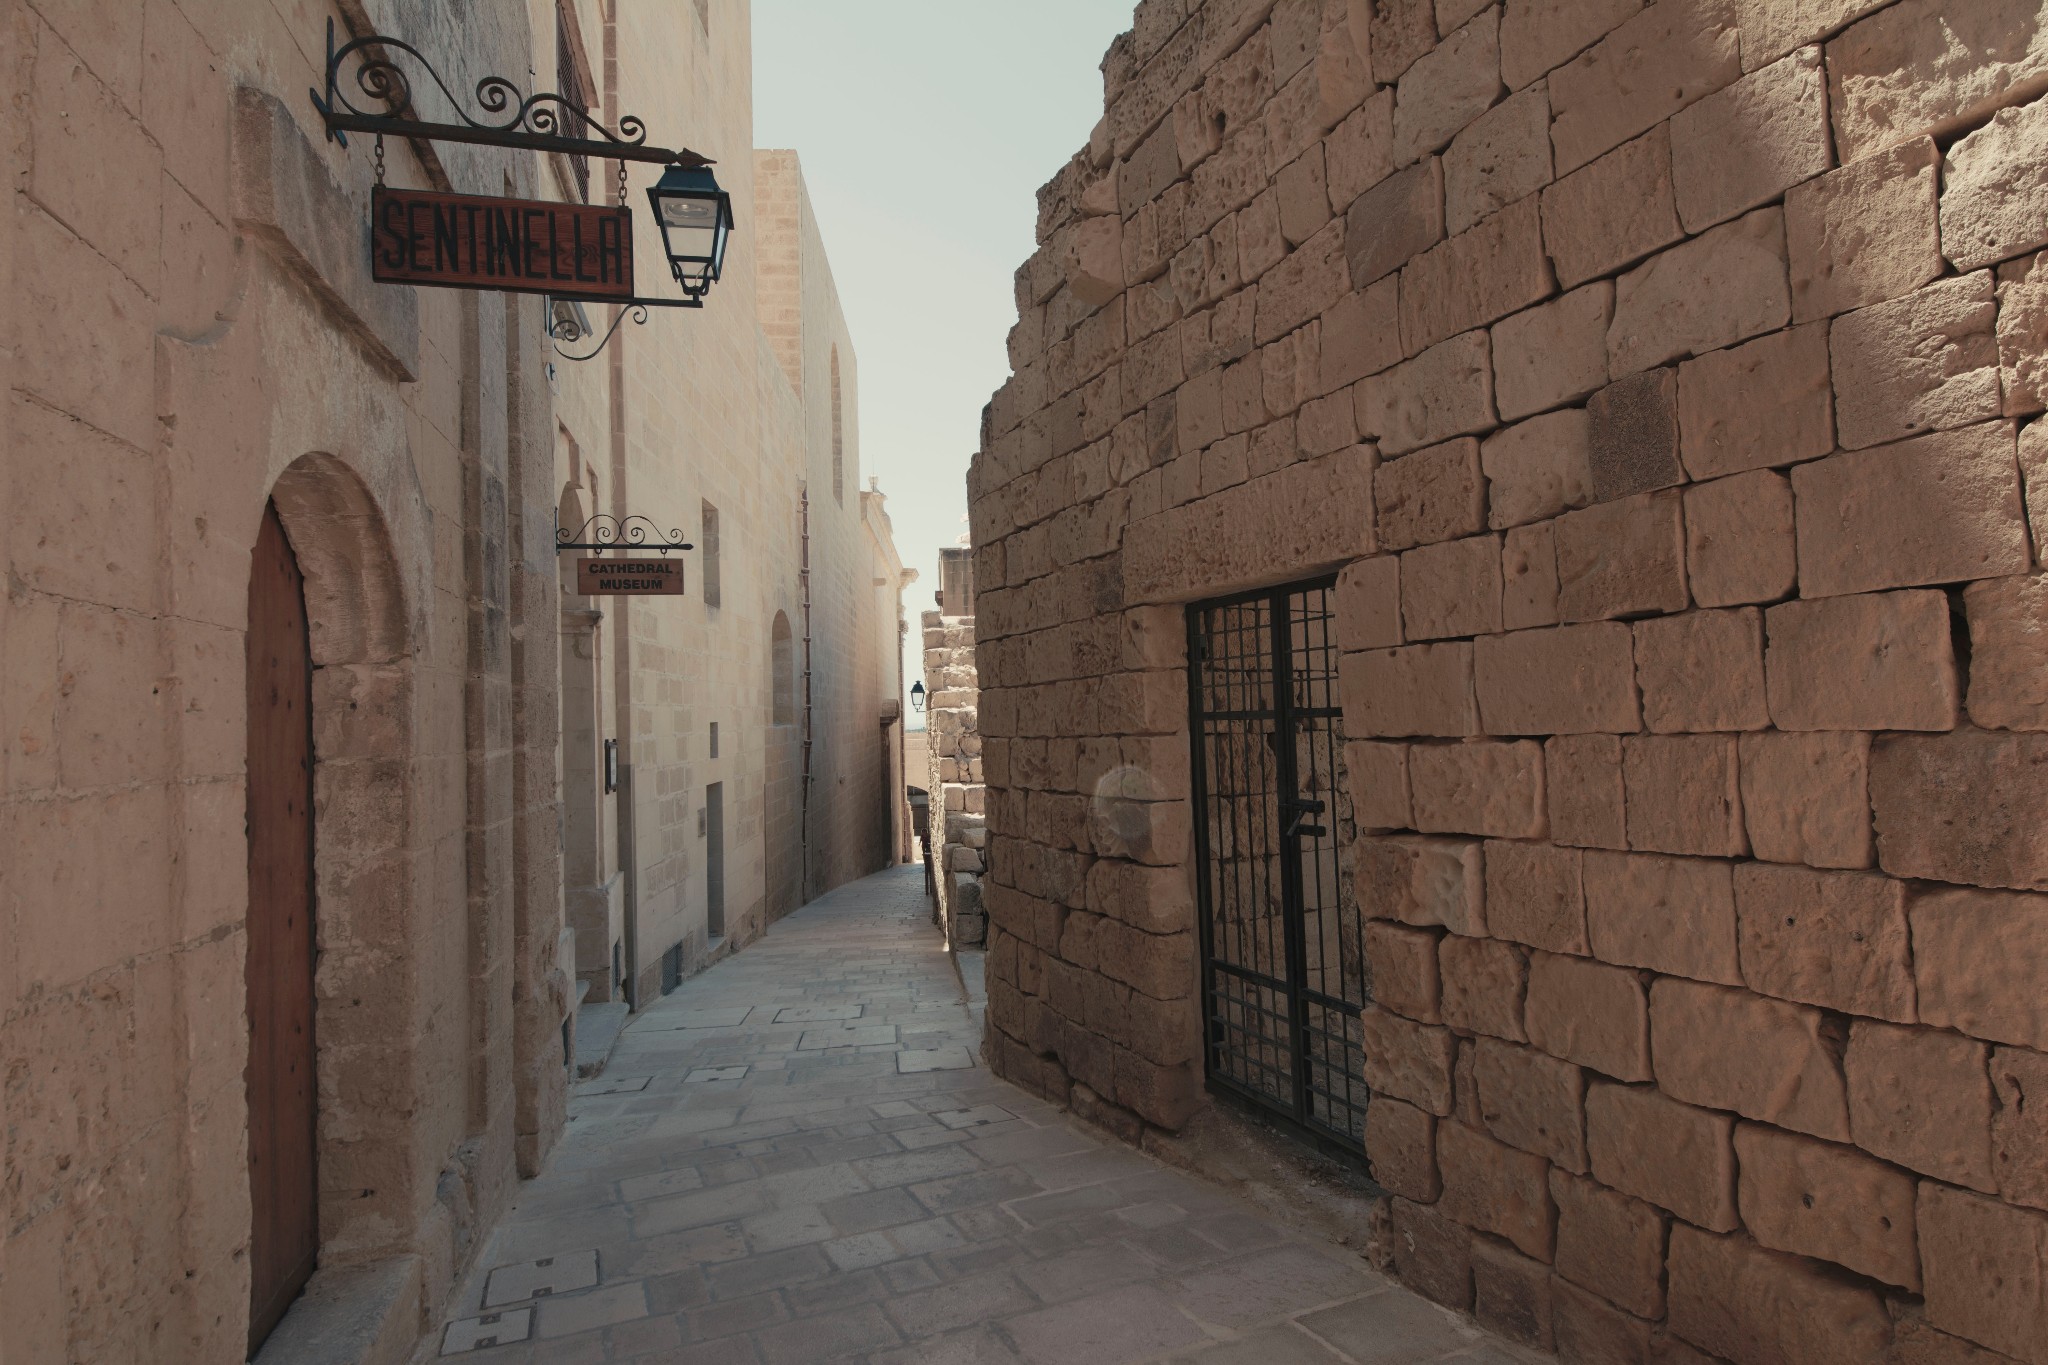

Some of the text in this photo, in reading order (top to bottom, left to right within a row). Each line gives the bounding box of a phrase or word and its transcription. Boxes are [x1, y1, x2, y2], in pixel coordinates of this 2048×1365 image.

[382, 202, 623, 283] SENTINELLA
[589, 563, 673, 574] CATHEDRAL
[600, 579, 662, 590] MUSEUM
